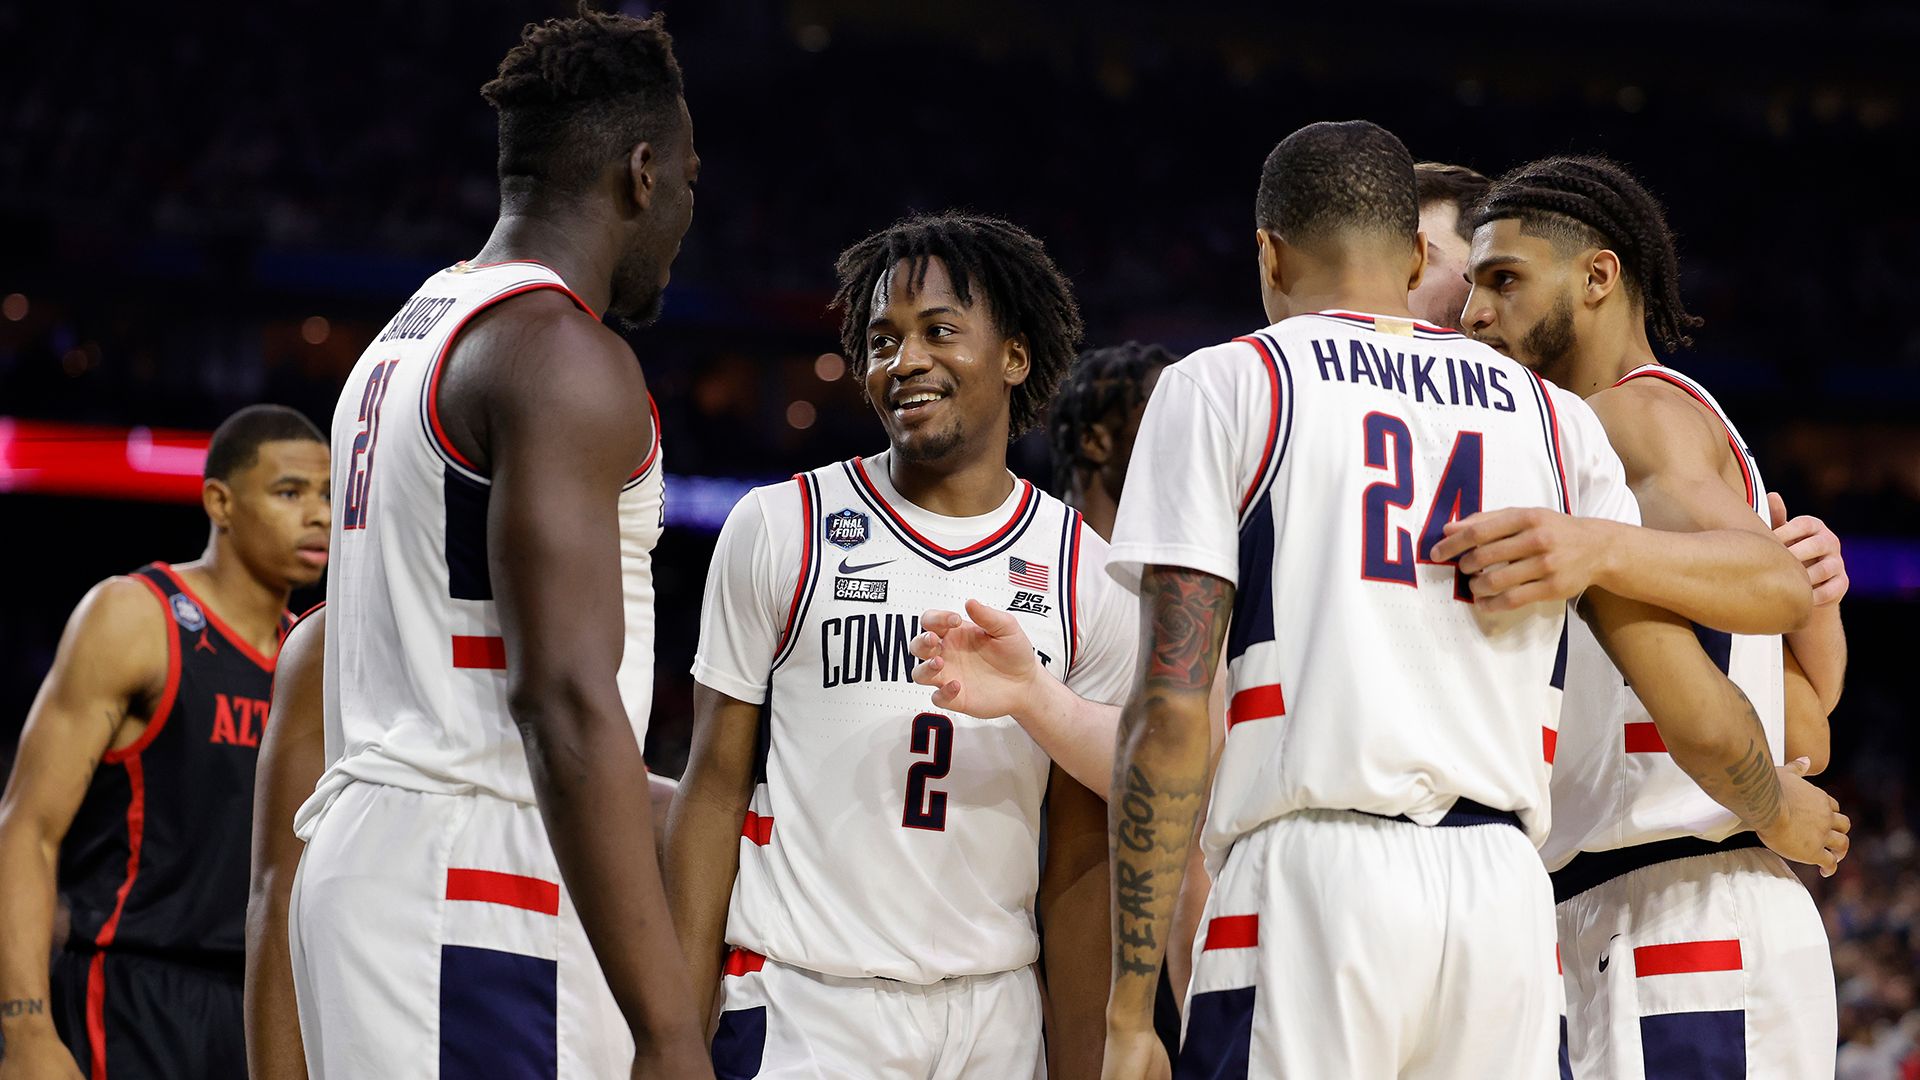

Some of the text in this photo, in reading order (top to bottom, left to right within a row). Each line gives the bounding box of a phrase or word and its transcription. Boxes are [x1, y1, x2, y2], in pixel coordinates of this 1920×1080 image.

[1311, 338, 1517, 412] HAWKINS
[343, 359, 400, 530] 21
[832, 518, 863, 528] FINAL
[1361, 410, 1485, 603] 24
[835, 527, 865, 538] FOUR
[836, 589, 886, 600] CHANGE
[1009, 600, 1052, 614] EAST
[1014, 591, 1045, 603] BIG
[902, 712, 954, 831] 2
[1117, 763, 1157, 977] FEAR GOD
